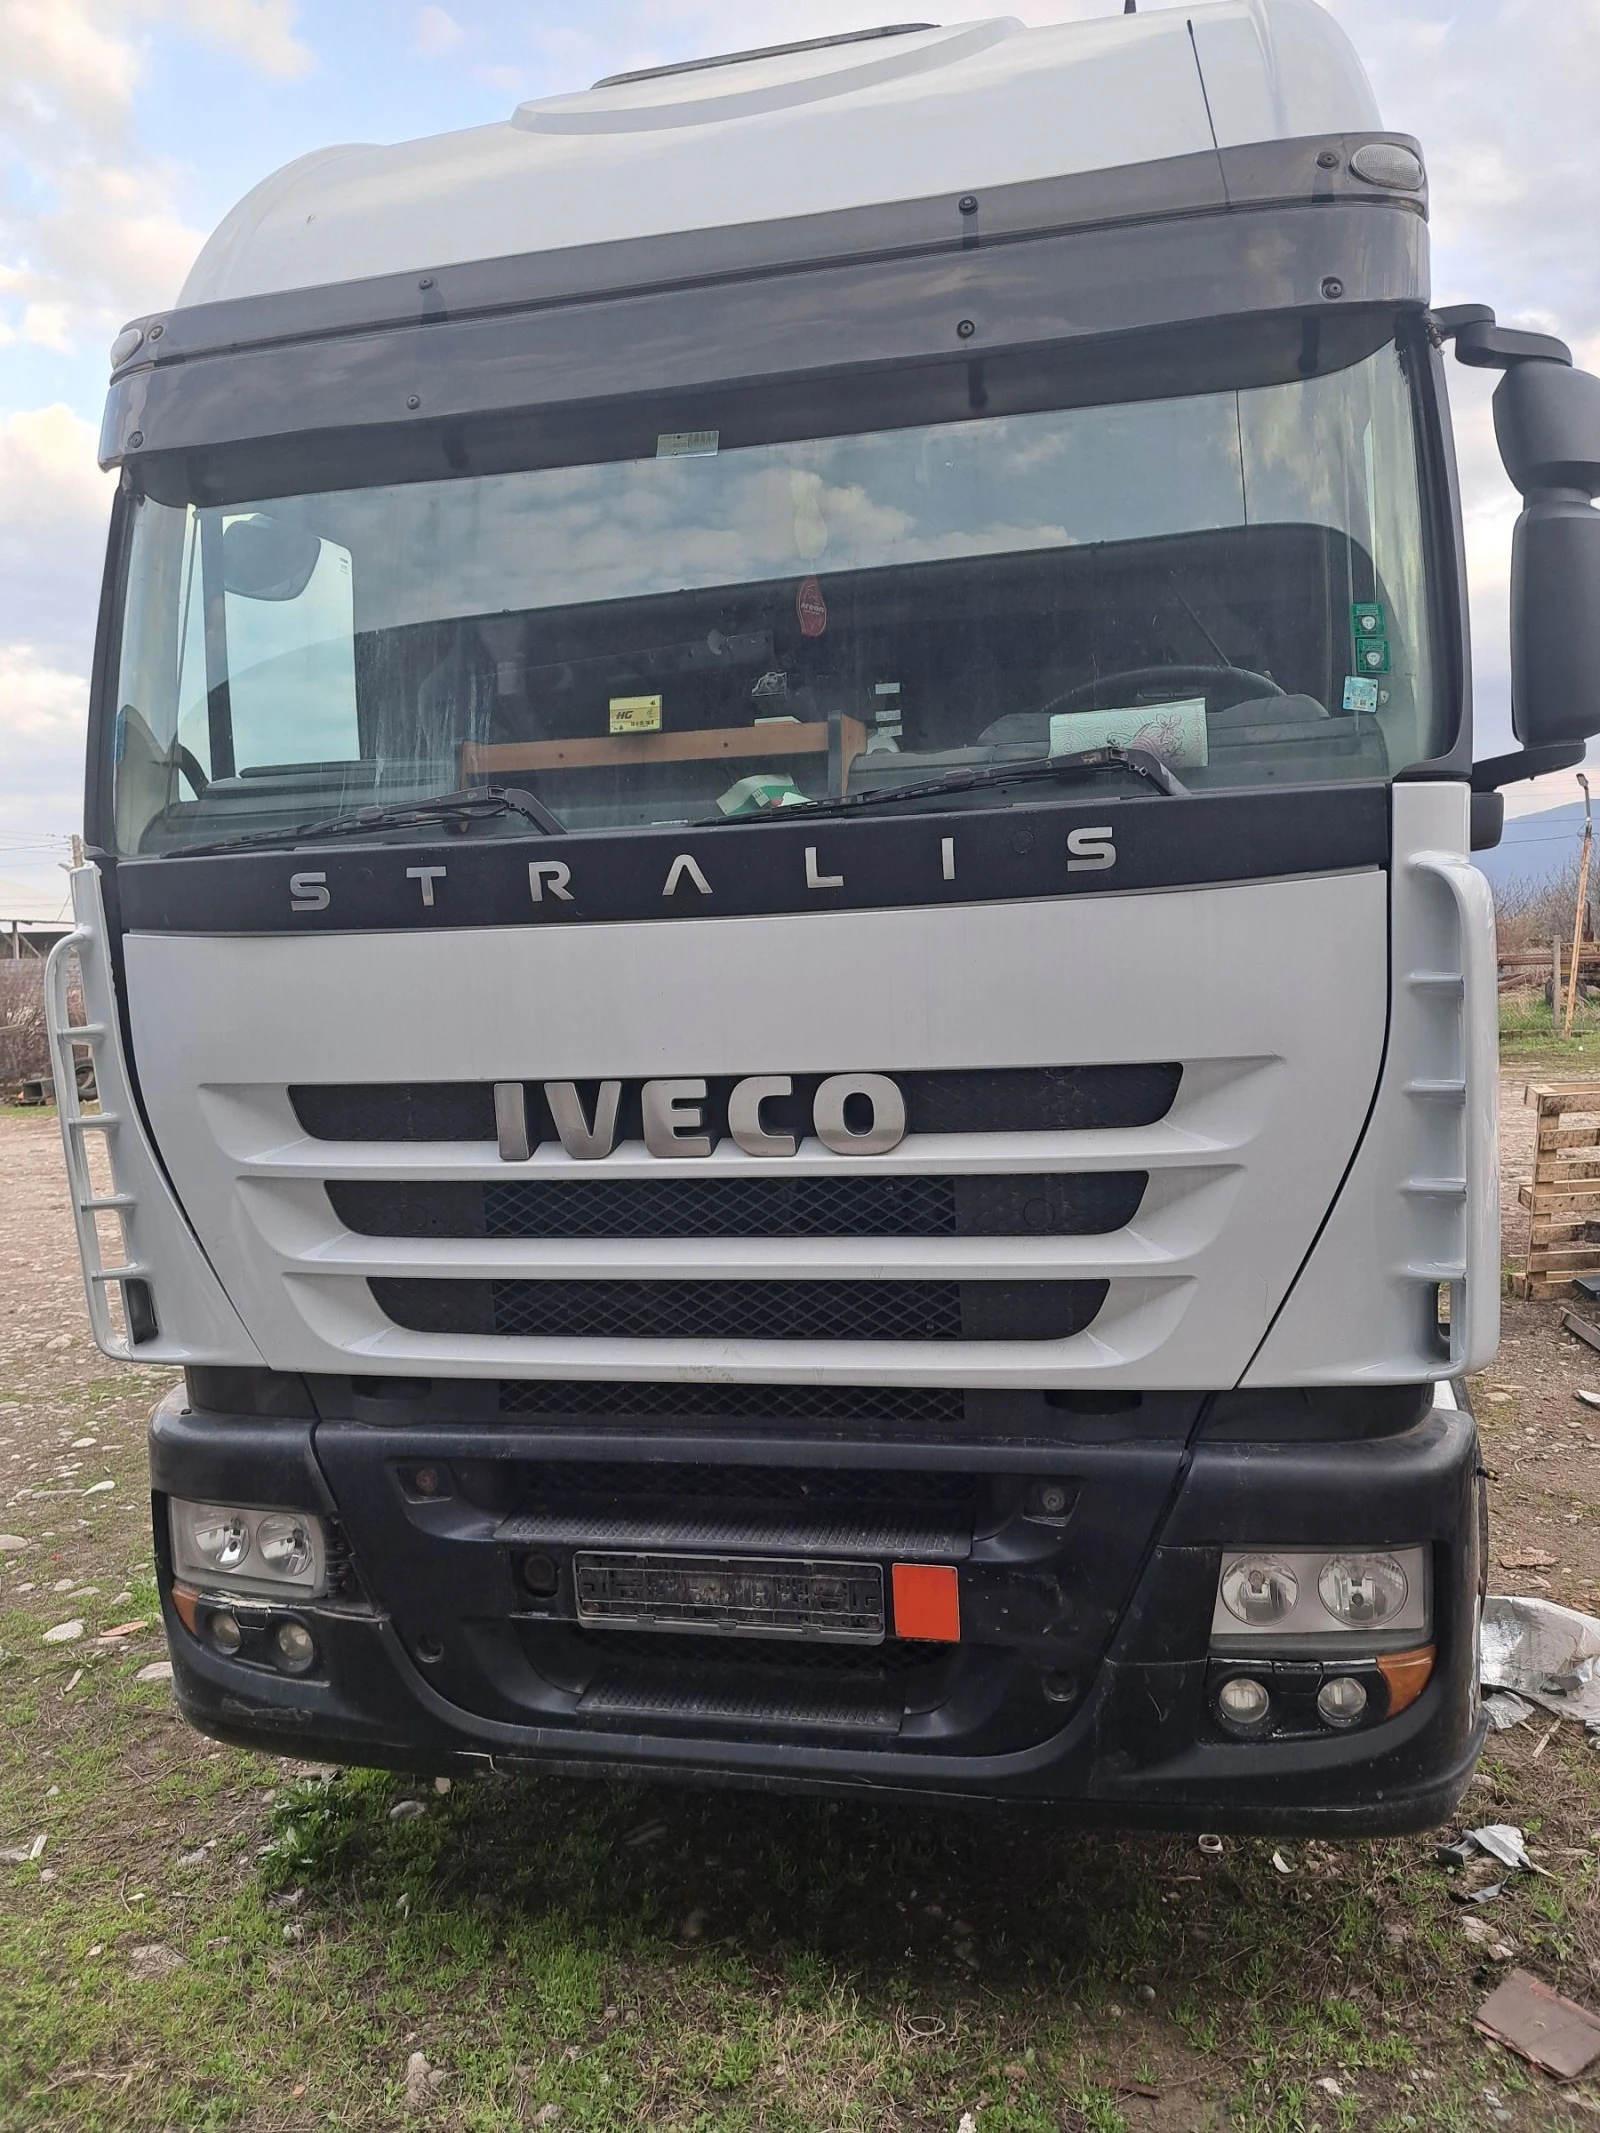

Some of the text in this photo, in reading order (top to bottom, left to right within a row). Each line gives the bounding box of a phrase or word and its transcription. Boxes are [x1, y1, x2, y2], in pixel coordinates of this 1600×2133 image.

[801, 602, 825, 612] areon
[290, 827, 1118, 912] STRALIS
[493, 1073, 906, 1160] IVECO
